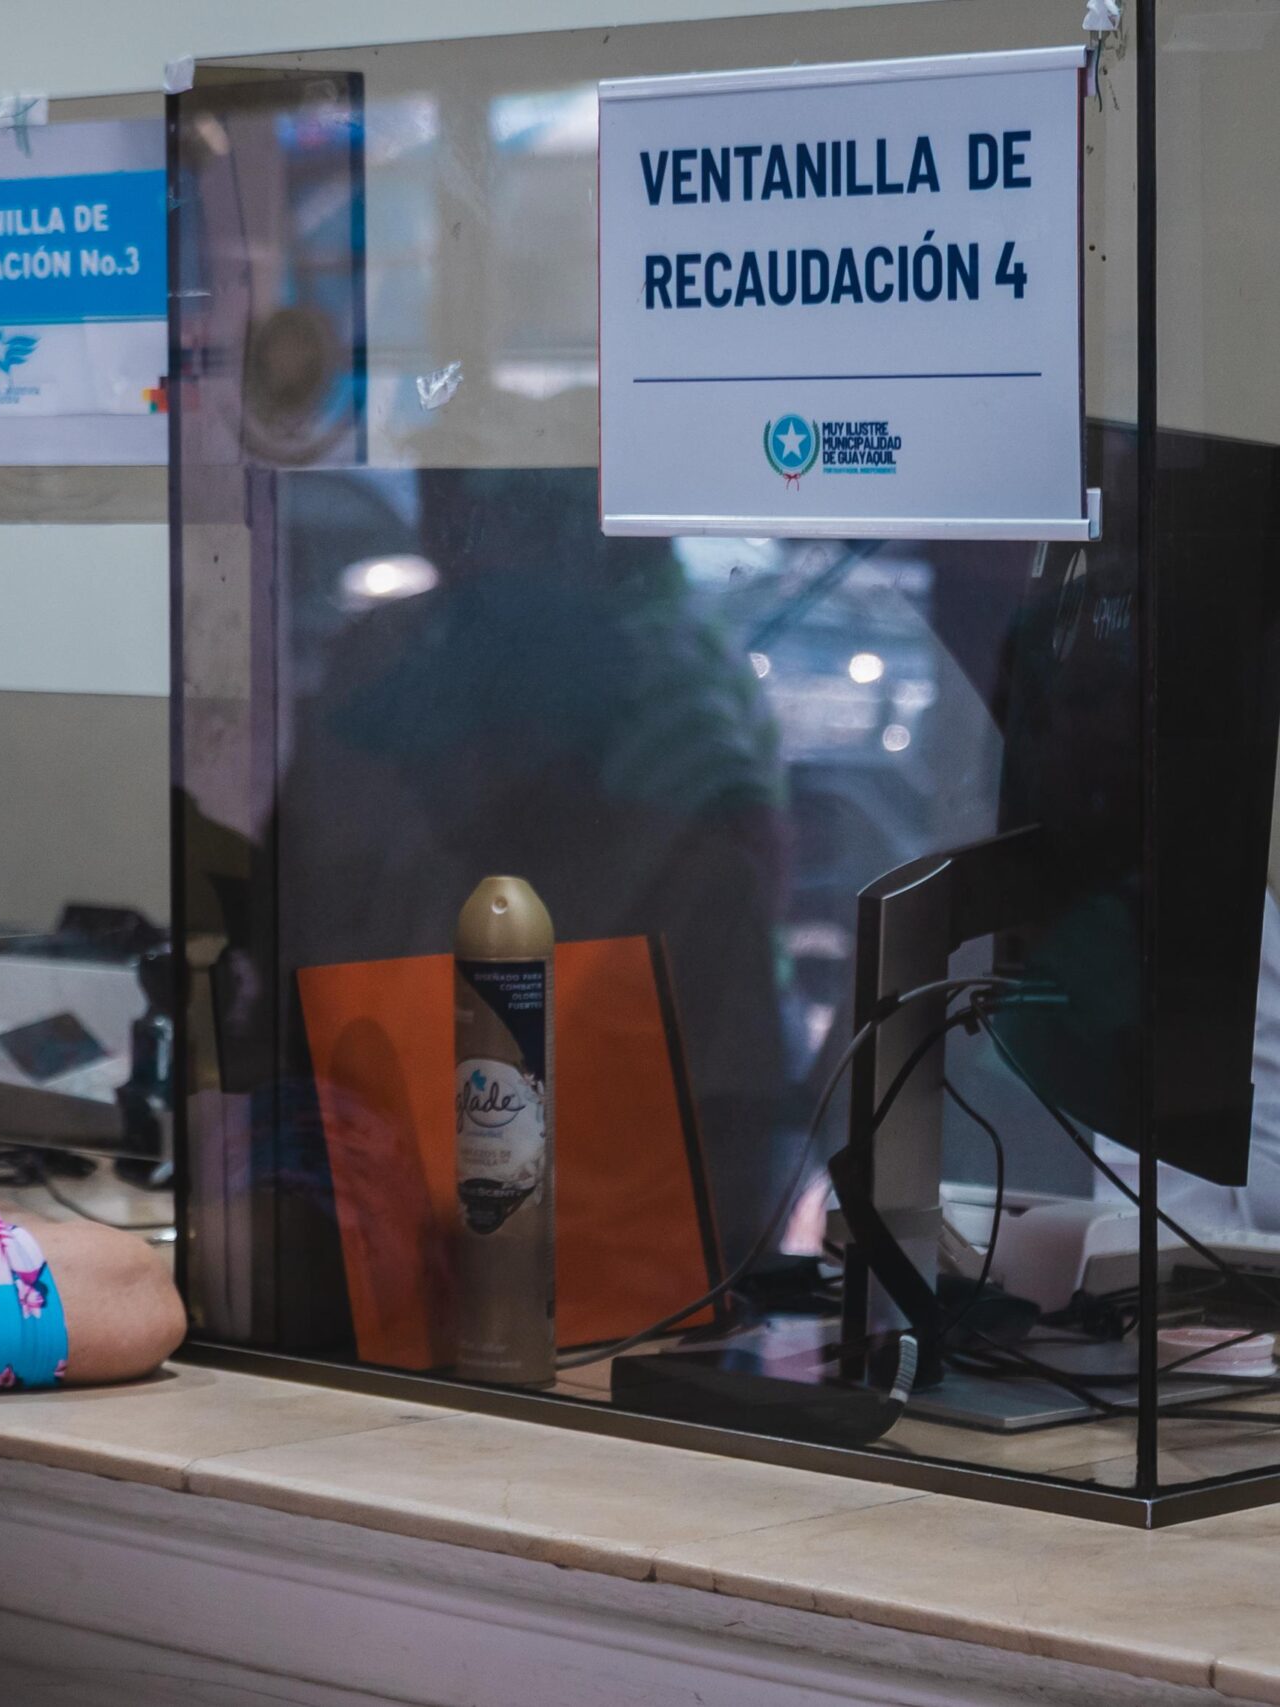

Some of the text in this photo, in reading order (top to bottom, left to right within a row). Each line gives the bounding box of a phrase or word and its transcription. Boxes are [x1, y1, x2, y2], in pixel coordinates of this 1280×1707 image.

[640, 130, 1032, 206] VENTANILLA DE
[74, 204, 110, 233] DE
[81, 246, 140, 277] No.3
[644, 230, 1028, 309] RECAUDACIÓN 4
[822, 422, 889, 436] MUY ILUSTRE
[822, 436, 902, 450] MUNICIPALIDAD
[822, 451, 897, 466] DE GUAYAQUIL
[456, 1081, 526, 1134] glade
